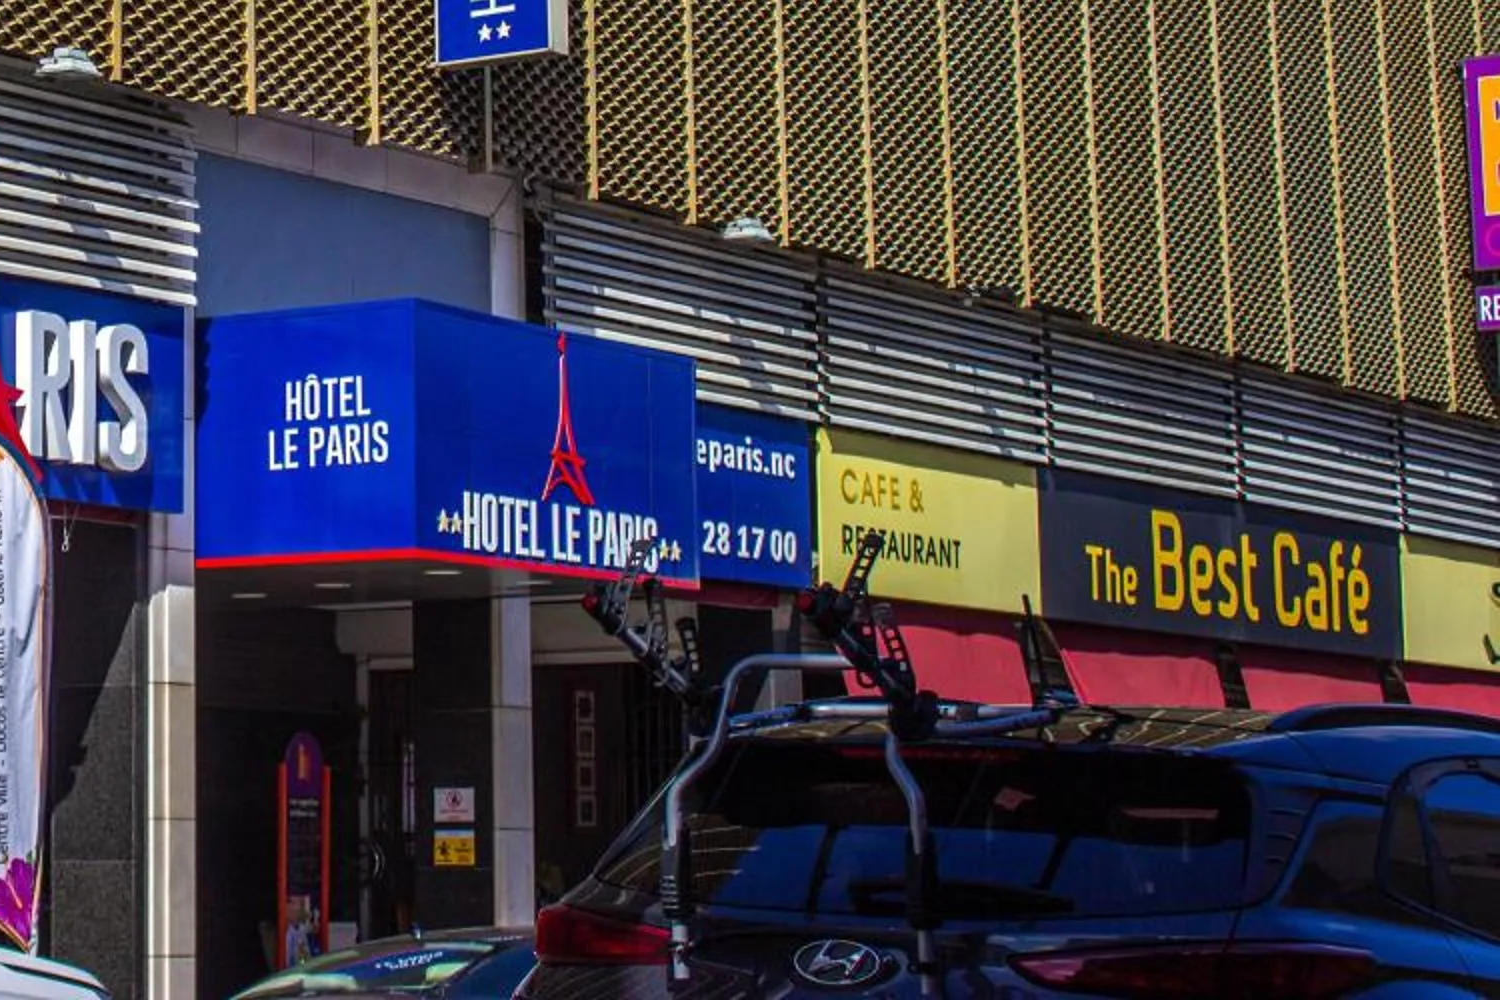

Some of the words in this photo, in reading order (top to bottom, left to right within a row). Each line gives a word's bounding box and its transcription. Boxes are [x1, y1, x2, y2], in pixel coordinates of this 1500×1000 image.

[285, 373, 371, 421] HÔTEL
[268, 428, 299, 470] LE
[308, 420, 389, 467] PARIS
[840, 468, 901, 510] CAFE
[909, 479, 925, 513] &
[463, 490, 546, 559] HOTEL
[551, 502, 581, 563] LE
[702, 520, 731, 555] 28
[737, 524, 765, 560] 17
[770, 529, 797, 564] 00
[842, 523, 961, 569] RETAURANT
[1085, 544, 1138, 605] The
[1151, 508, 1260, 623] Best
[1273, 530, 1371, 635] Café
